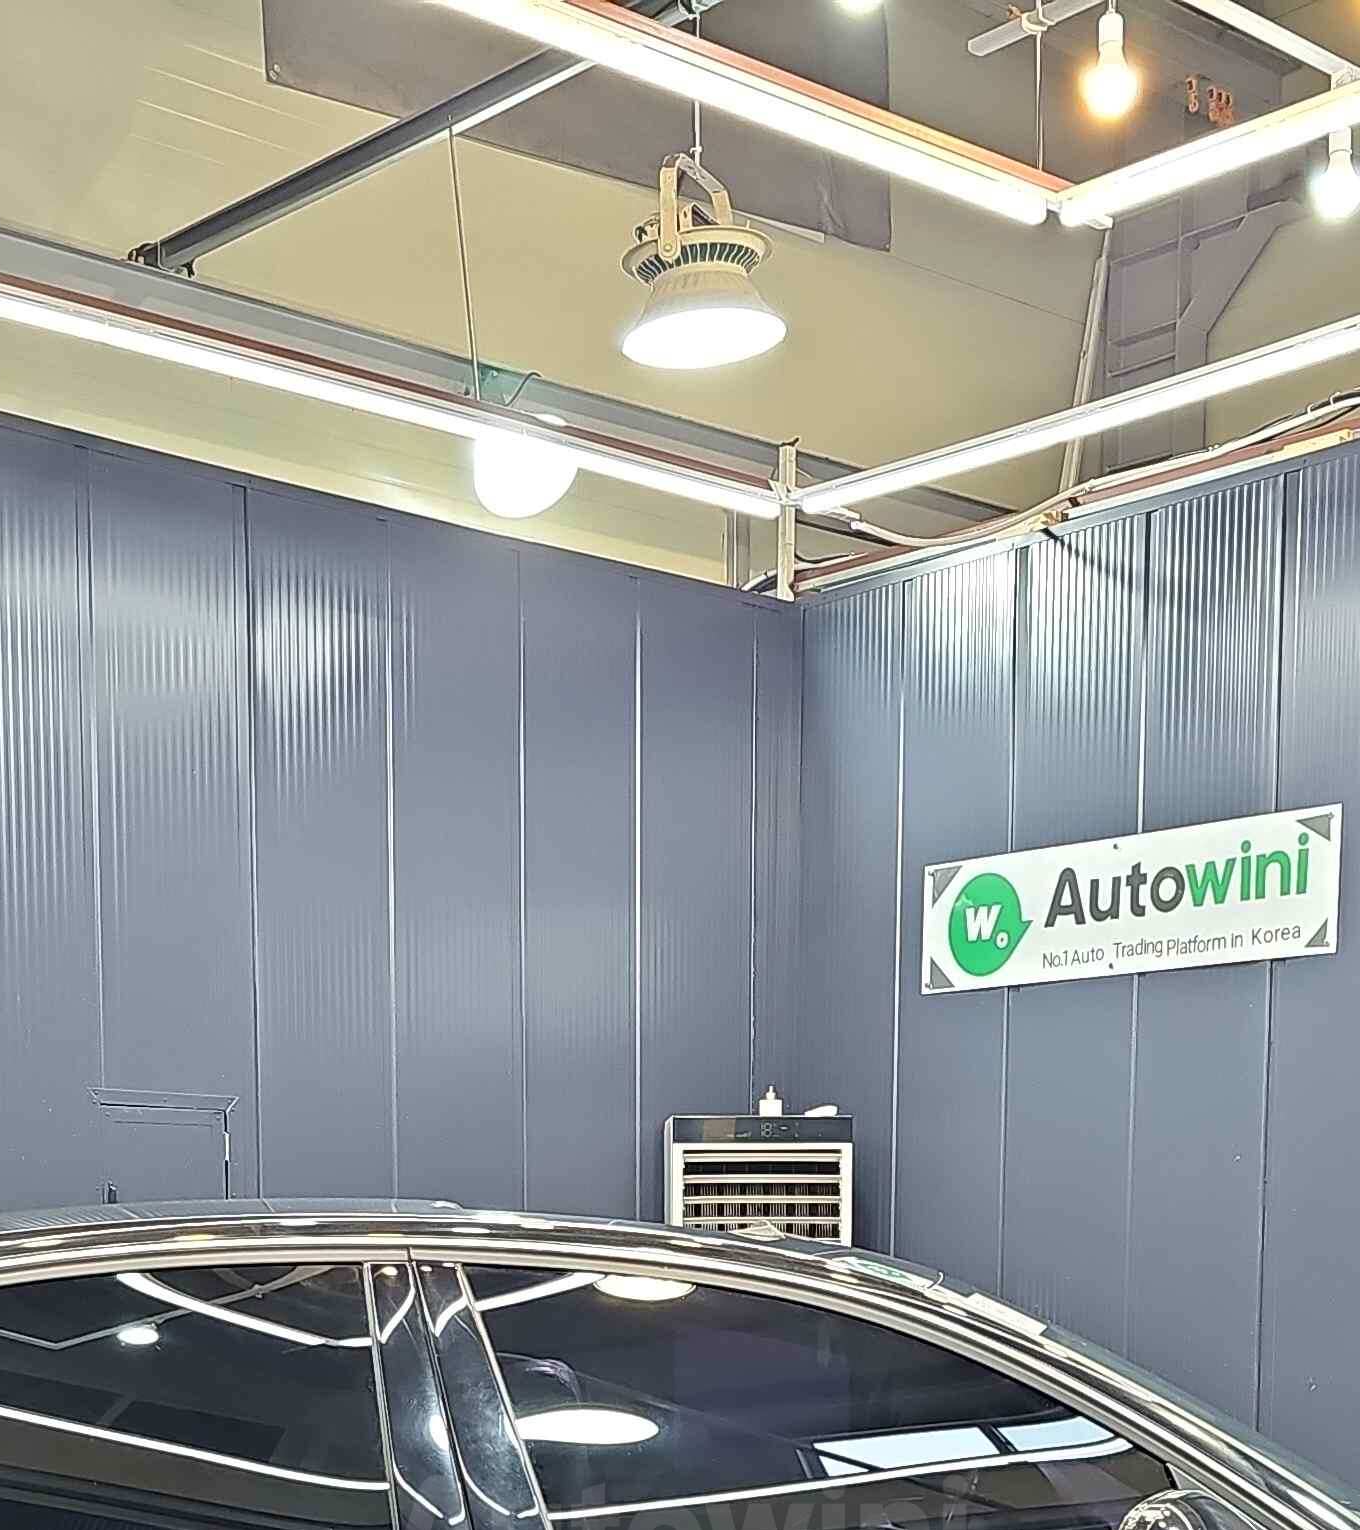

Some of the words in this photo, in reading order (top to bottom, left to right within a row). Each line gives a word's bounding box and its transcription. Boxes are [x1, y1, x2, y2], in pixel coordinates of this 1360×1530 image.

[1043, 832, 1310, 928] Autowini
[1113, 937, 1163, 959] Trading
[1166, 934, 1227, 956] Platform
[1251, 924, 1302, 946] Korea
